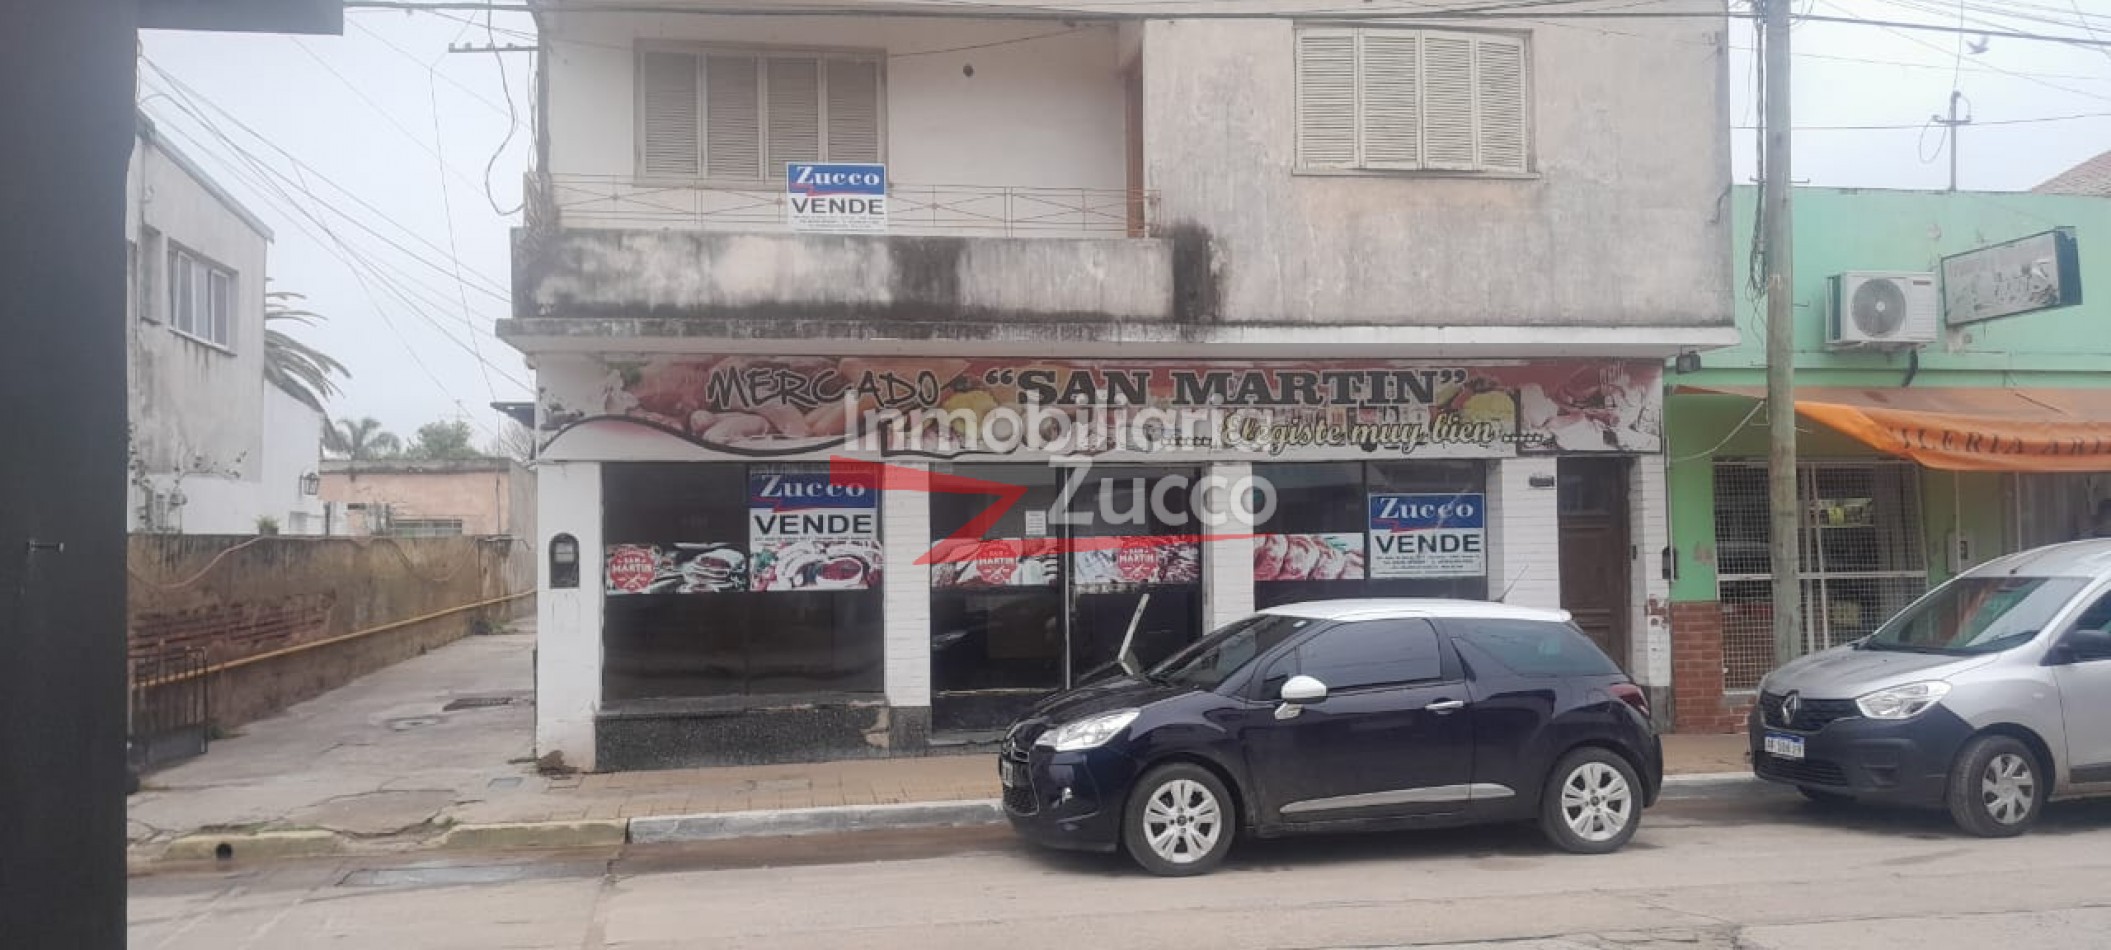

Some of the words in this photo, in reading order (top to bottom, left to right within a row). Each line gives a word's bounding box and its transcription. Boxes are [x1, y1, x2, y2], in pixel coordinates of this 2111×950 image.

[796, 166, 880, 186] Zucco
[792, 198, 885, 215] VENDE
[706, 367, 941, 410] MERCADO
[1221, 412, 1347, 456] Elegiste
[1347, 422, 1430, 454] muy
[1430, 413, 1495, 444] bien
[760, 474, 865, 498] Zucco
[1380, 497, 1475, 519] Zucco
[754, 513, 872, 535] VENDE
[1375, 533, 1481, 554] VENDE
[611, 563, 653, 573] MARTIN
[1119, 553, 1155, 563] MARTIN
